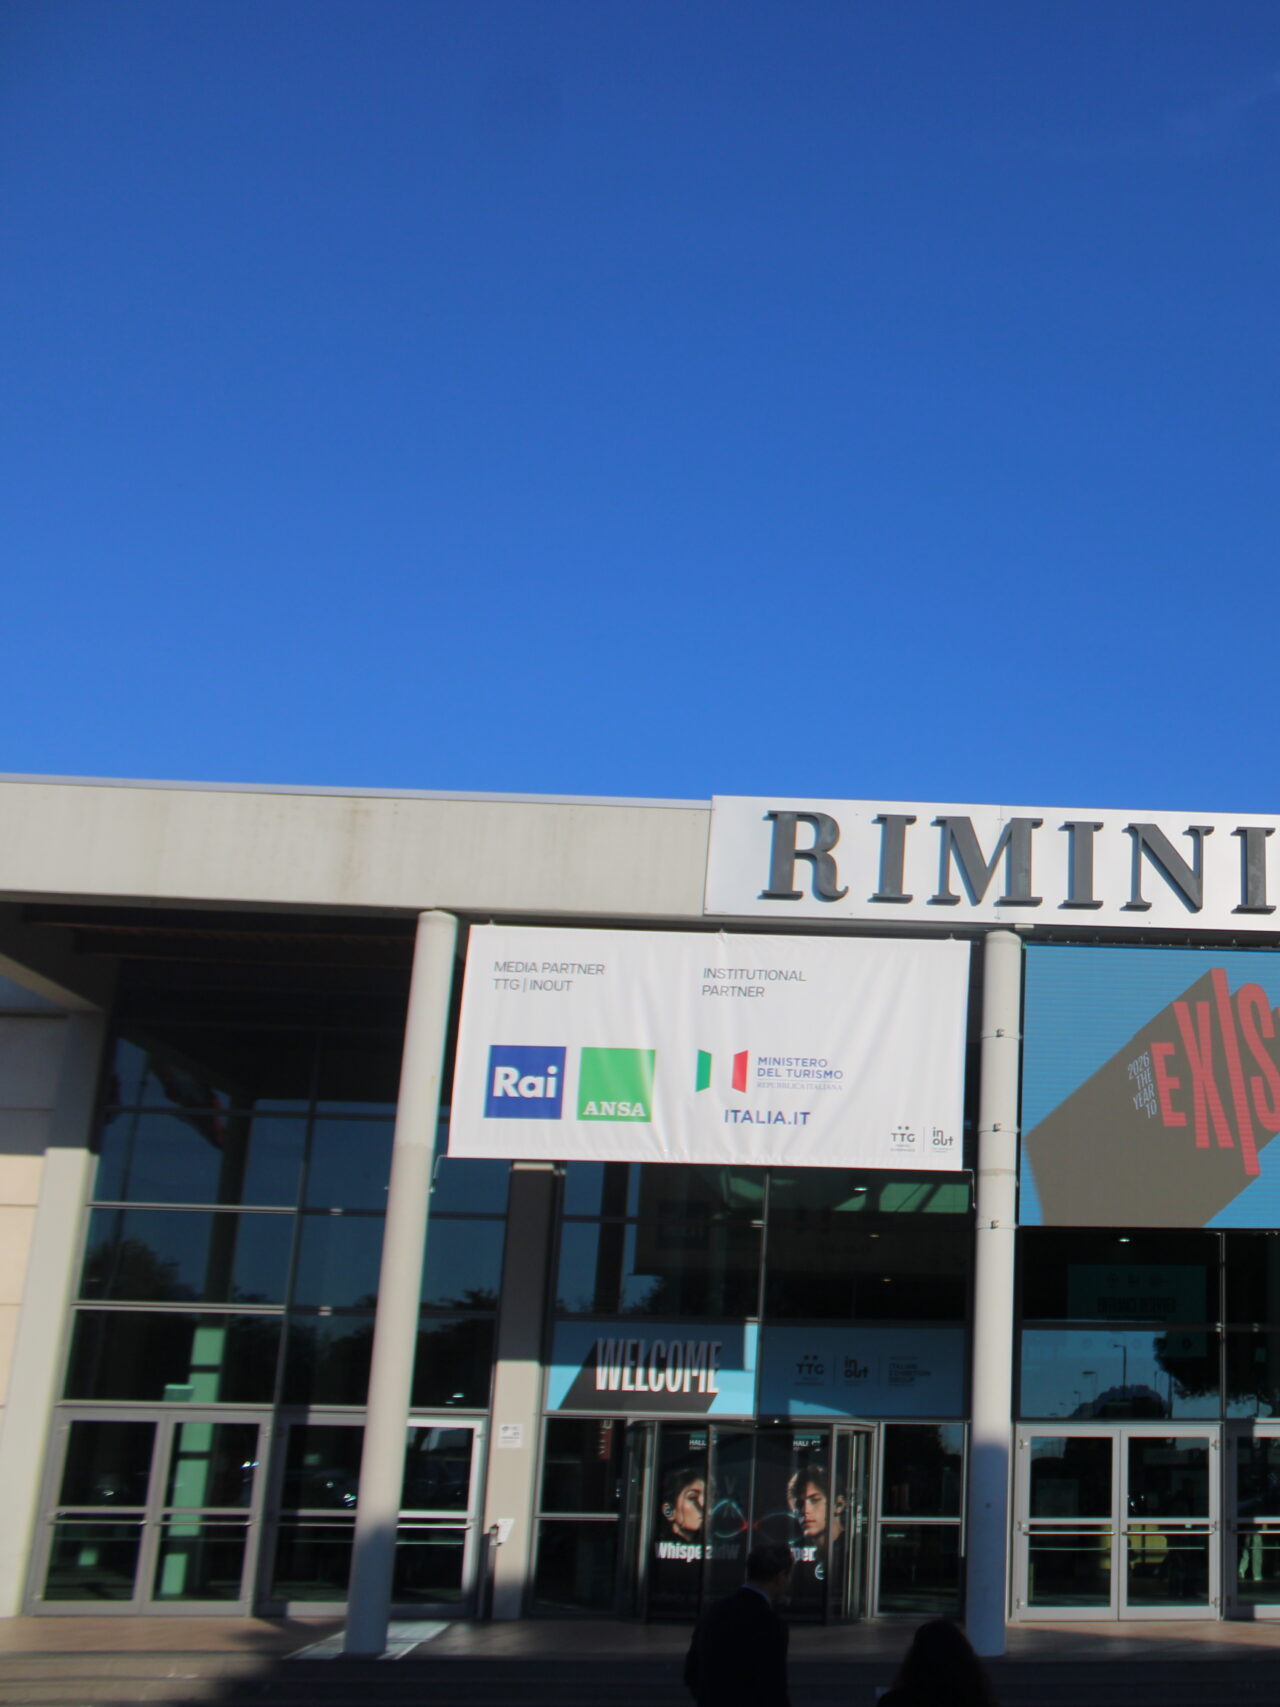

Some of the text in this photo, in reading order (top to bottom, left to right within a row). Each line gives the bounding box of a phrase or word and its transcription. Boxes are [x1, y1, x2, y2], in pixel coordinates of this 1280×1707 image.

[758, 810, 1276, 915] RIMINI
[493, 961, 606, 975] MEDIA PARTNER
[703, 968, 807, 982] INSTITUTIONAL
[493, 978, 520, 991] TTG
[530, 980, 573, 992] INOUT
[702, 985, 765, 998] PARTNER
[757, 1056, 828, 1068] MINISTERO
[757, 1067, 844, 1080] DEL TURISMO
[493, 1065, 557, 1098] Rai
[1133, 1083, 1156, 1110] YEAR
[582, 1101, 647, 1118] ANSA
[724, 1109, 811, 1126] ITALIA.IT
[595, 1337, 723, 1394] WELCOME
